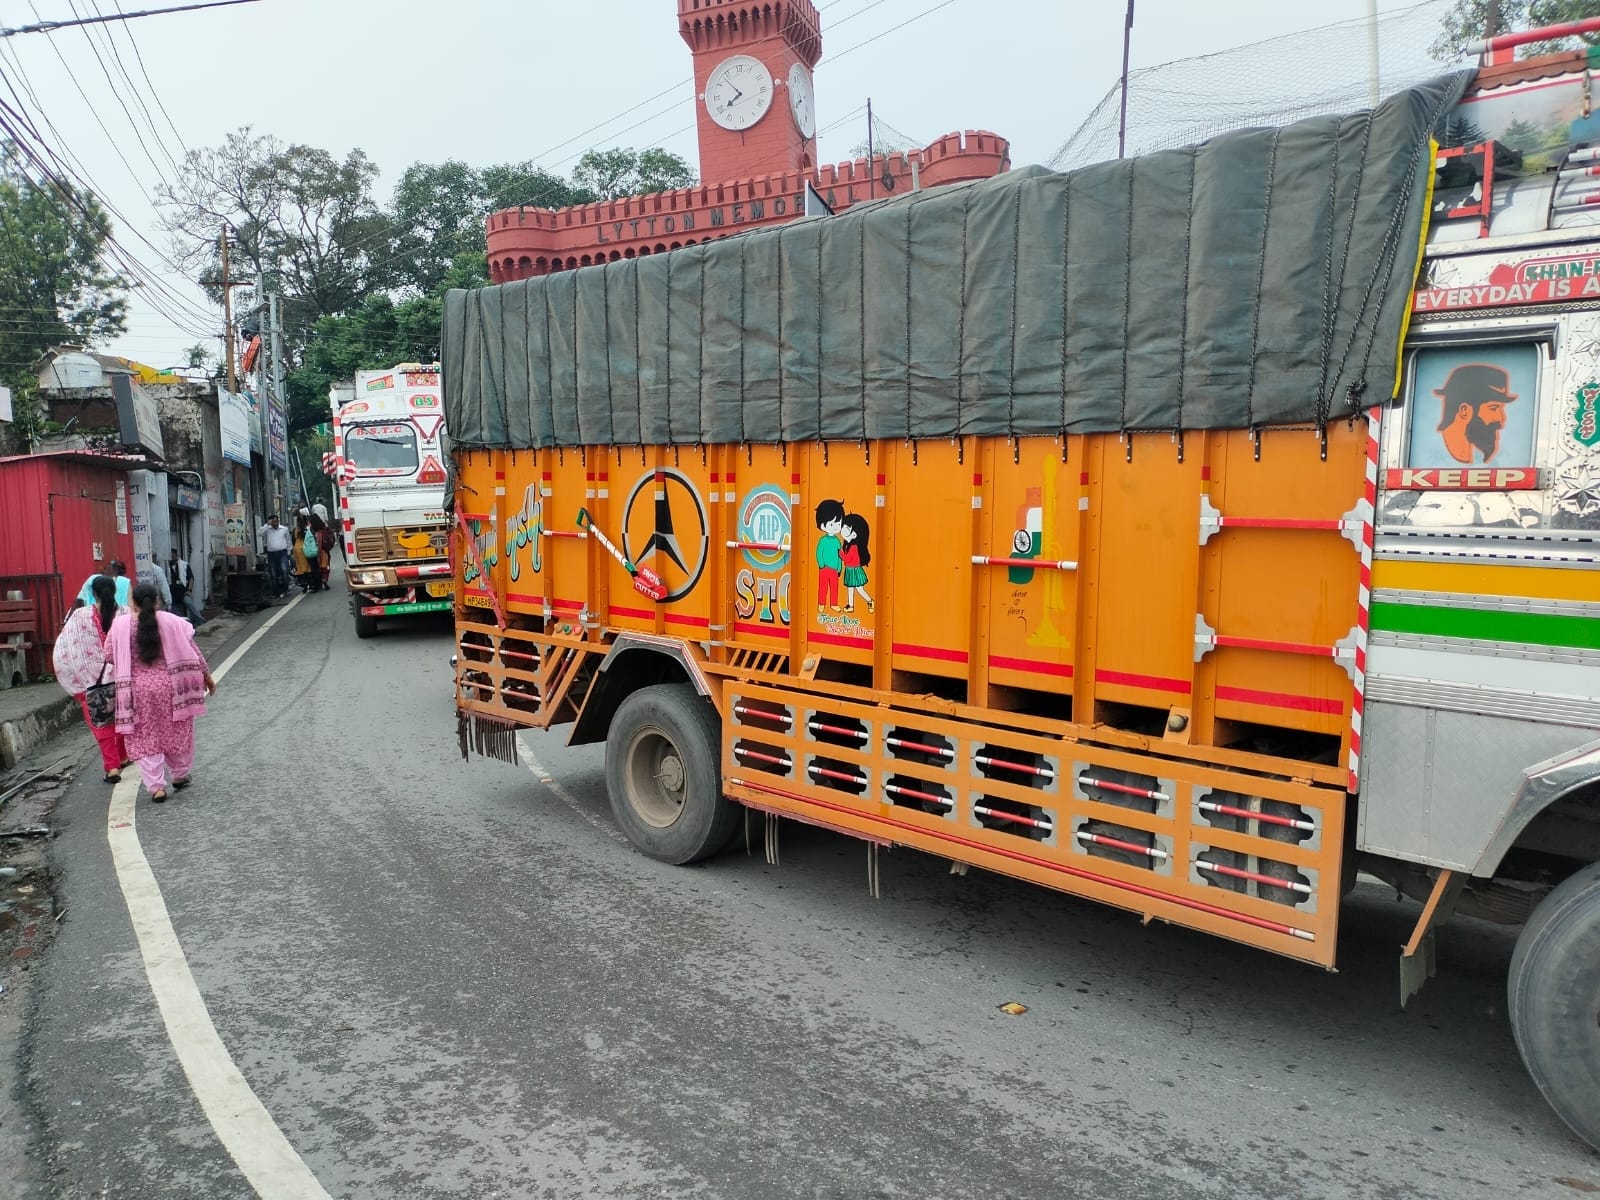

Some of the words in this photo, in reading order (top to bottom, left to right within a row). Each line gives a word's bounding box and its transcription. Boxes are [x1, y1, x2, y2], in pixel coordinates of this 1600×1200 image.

[597, 211, 695, 243] LYTTON
[710, 183, 862, 227] MEMORAL
[1415, 282, 1539, 309] EVERYDAY
[1548, 278, 1571, 298] IS
[1401, 469, 1526, 488] KEEP
[758, 514, 779, 542] AIP
[642, 567, 661, 586] SNOW
[635, 581, 660, 599] CUTTER
